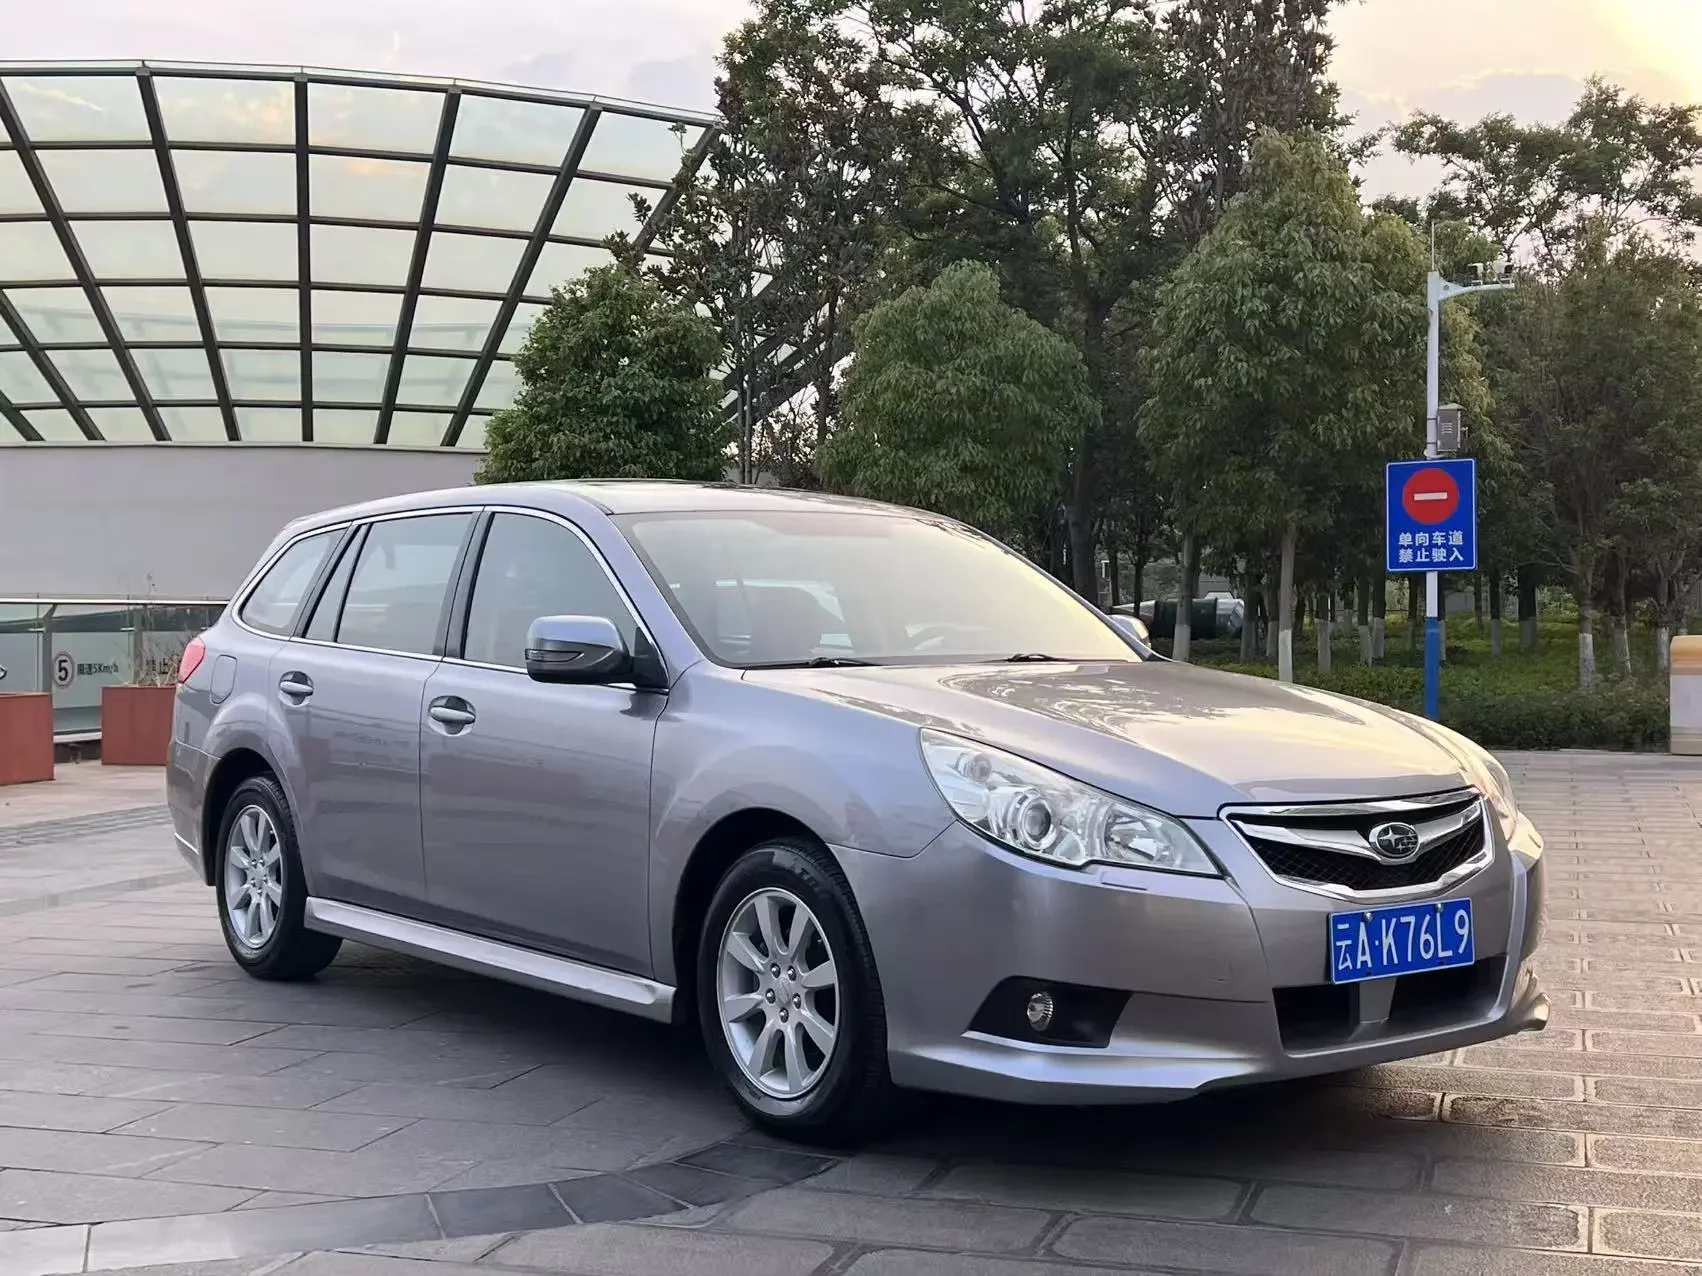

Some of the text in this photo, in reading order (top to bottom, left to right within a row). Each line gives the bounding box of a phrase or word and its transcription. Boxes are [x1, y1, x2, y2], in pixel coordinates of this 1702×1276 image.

[1398, 530, 1464, 546] 单向车道
[1398, 547, 1464, 563] 禁止驶入
[58, 659, 68, 681] 5
